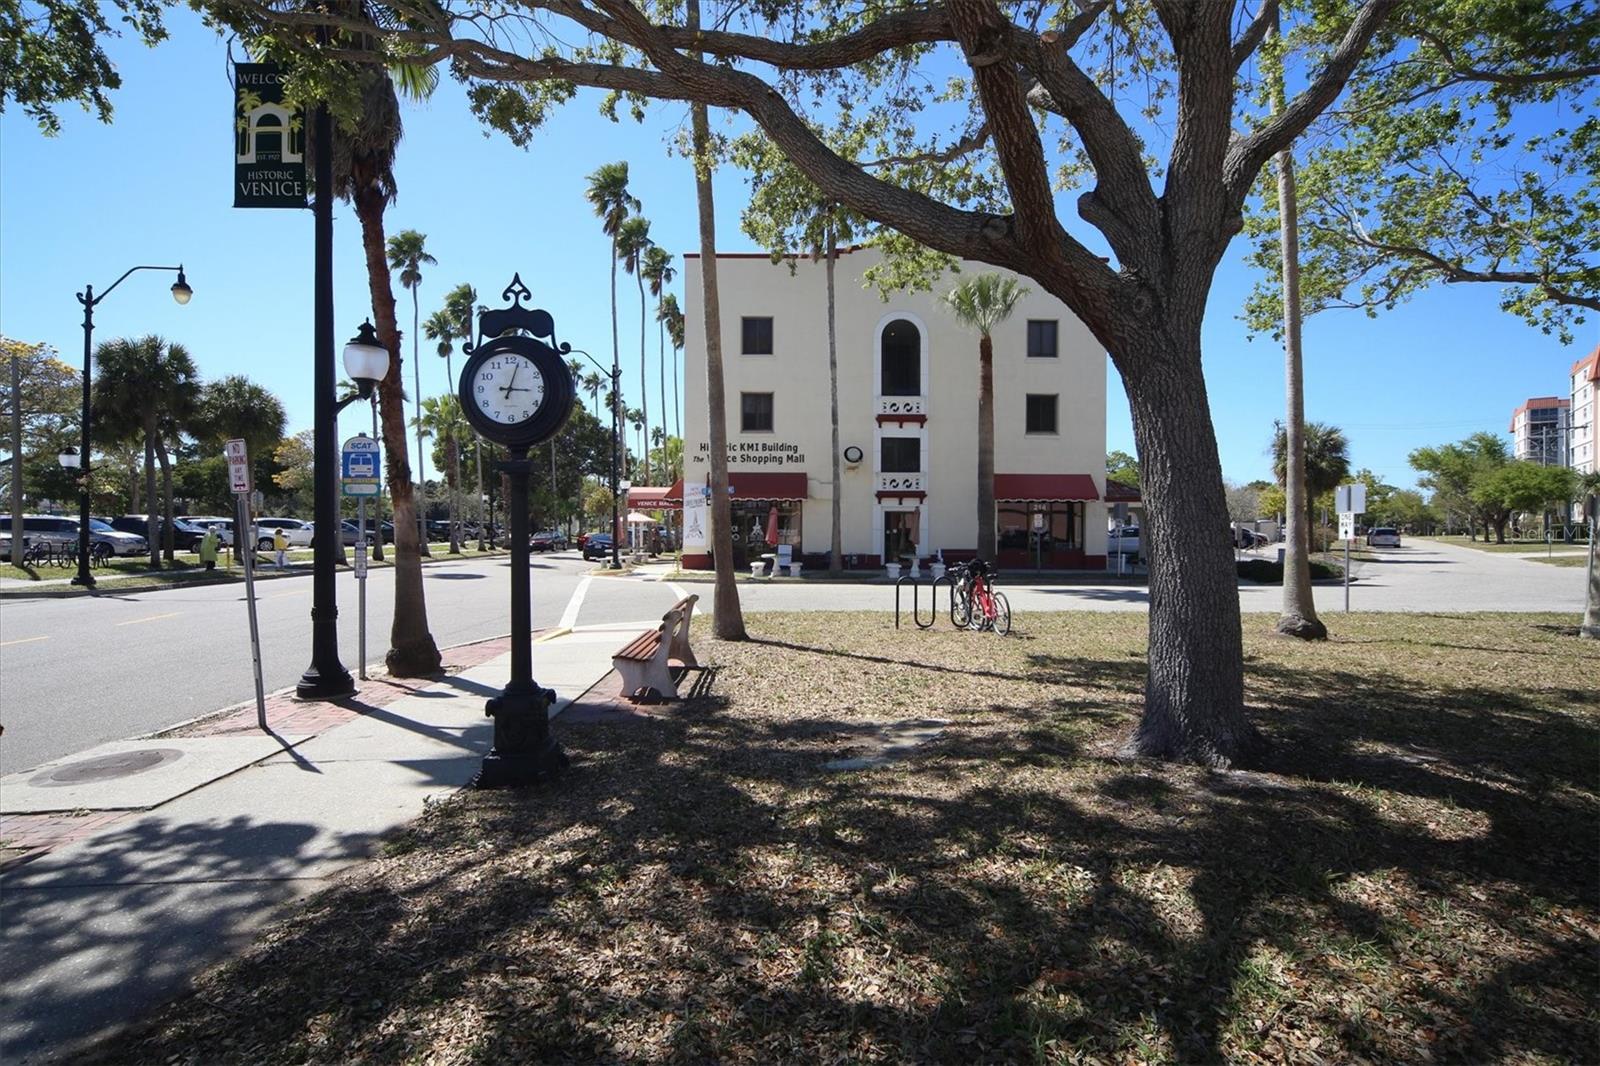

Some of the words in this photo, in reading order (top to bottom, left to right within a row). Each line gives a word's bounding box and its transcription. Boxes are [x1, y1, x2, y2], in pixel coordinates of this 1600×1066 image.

[238, 73, 287, 84] WELCO
[248, 170, 294, 180] HISTORIC
[240, 181, 302, 196] VENICE
[533, 371, 540, 379] 2
[482, 400, 490, 408] 8
[532, 400, 539, 408] 4
[494, 411, 501, 419] 7
[232, 443, 240, 454] NO
[350, 442, 373, 450] SCAT
[700, 443, 737, 452] Hiic
[740, 443, 760, 452] KMI
[761, 442, 798, 454] Building
[693, 455, 705, 463] The
[740, 454, 783, 465] Shopping
[786, 454, 805, 463] Mall
